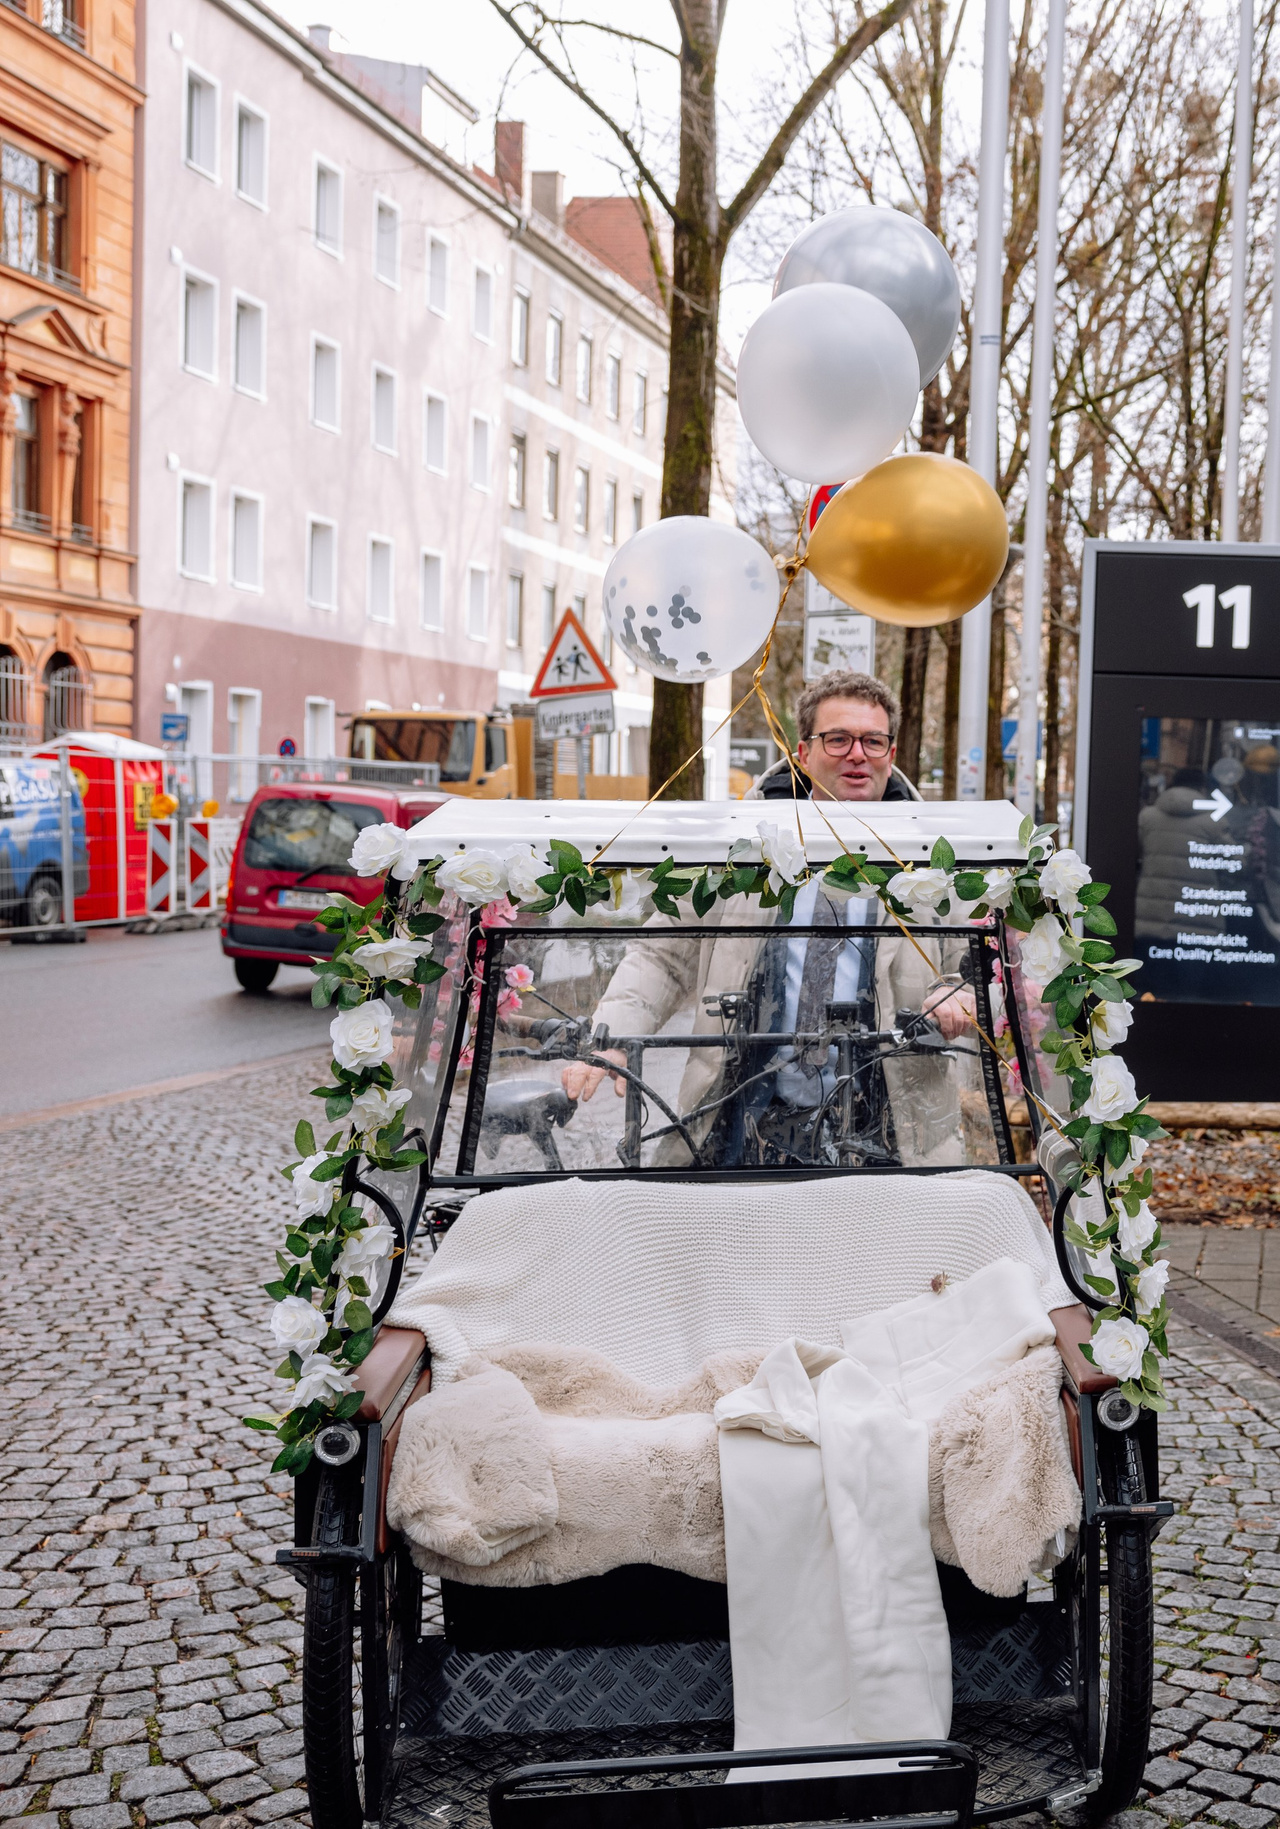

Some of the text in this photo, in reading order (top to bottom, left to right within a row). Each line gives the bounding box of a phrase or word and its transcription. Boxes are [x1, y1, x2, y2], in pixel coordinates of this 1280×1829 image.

[1182, 584, 1252, 650] 11
[541, 706, 612, 727] Kindergarten
[1188, 841, 1244, 857] Trauungen
[1188, 857, 1242, 873] Weddings
[1182, 887, 1247, 901] Standesamt
[1174, 901, 1253, 917] Registry Office
[1177, 932, 1248, 947] Heimaufsicht
[1149, 946, 1275, 964] Care Quality Supervision
